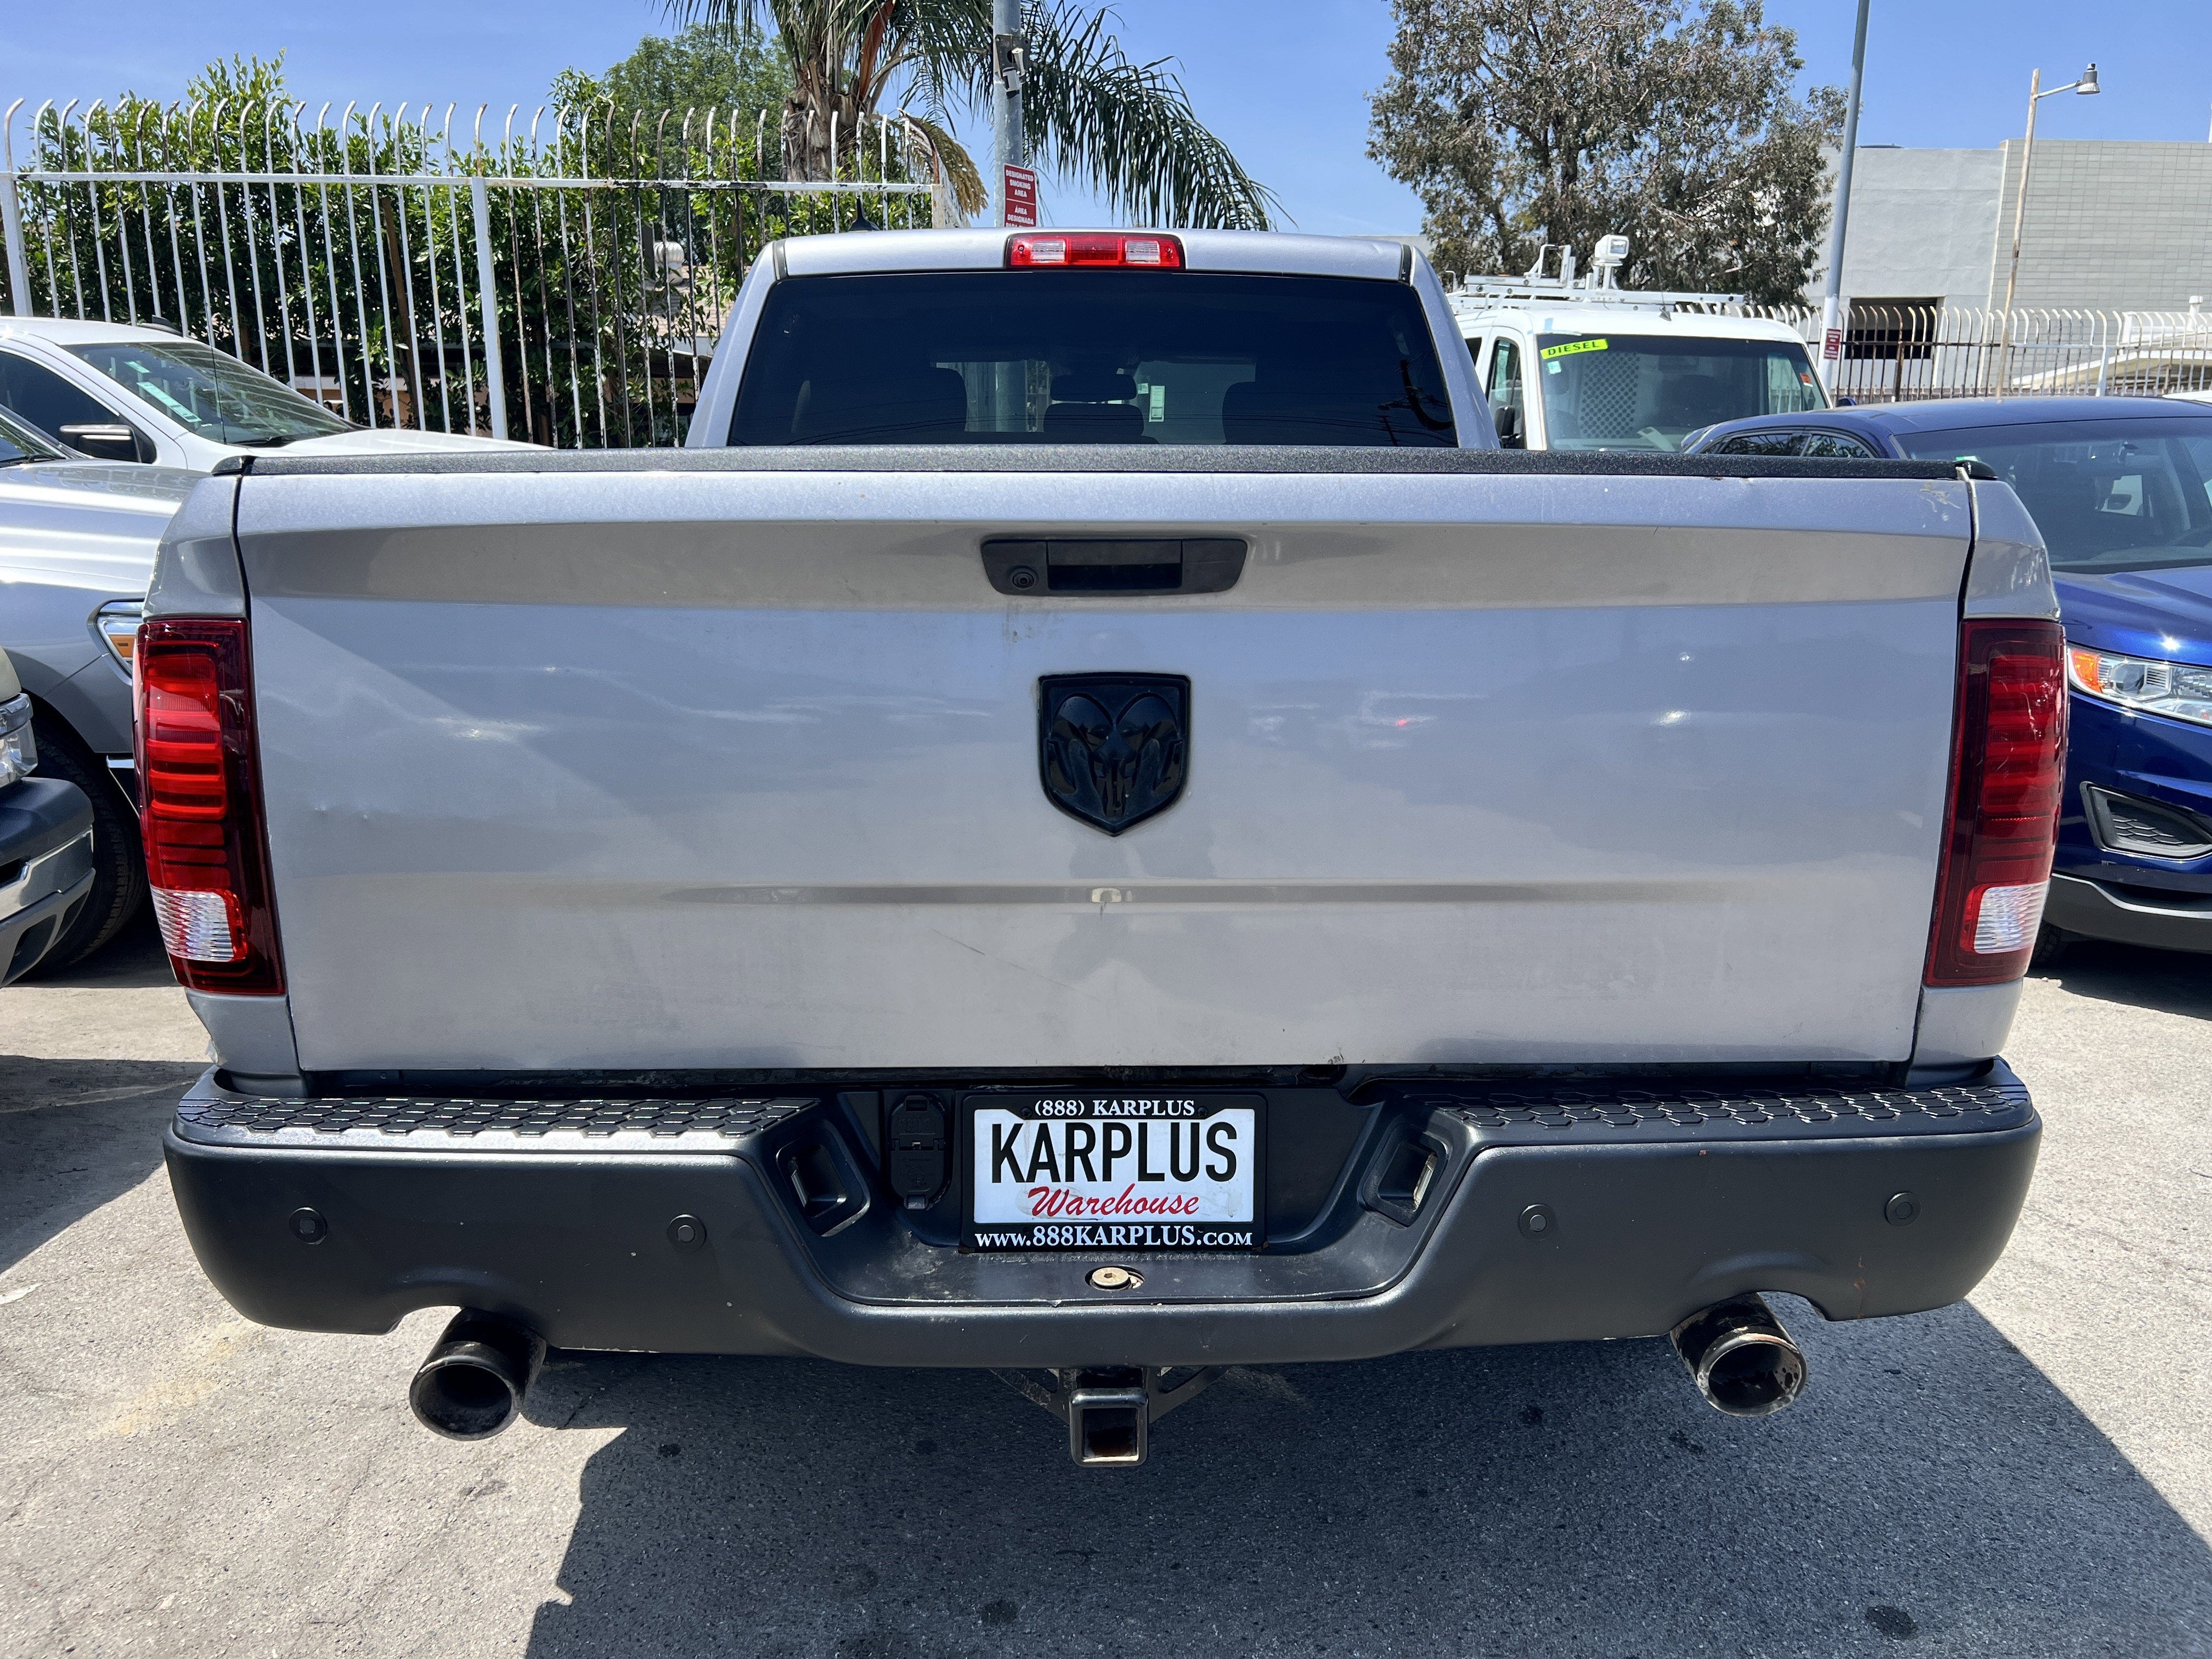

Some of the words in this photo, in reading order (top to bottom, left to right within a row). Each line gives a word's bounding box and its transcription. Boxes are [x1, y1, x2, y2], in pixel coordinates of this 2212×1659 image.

[1006, 170, 1034, 182] DESIGNATED
[1009, 179, 1031, 190] SMOKING
[1014, 189, 1027, 198] AREA
[1007, 214, 1034, 225] DESIGNADA
[1548, 341, 1599, 356] DIESEL
[1035, 1099, 1085, 1116] (888)
[1092, 1100, 1195, 1116] KARPLUS
[992, 1122, 1237, 1183] KARPLUS
[1028, 1183, 1199, 1216] Warehouse
